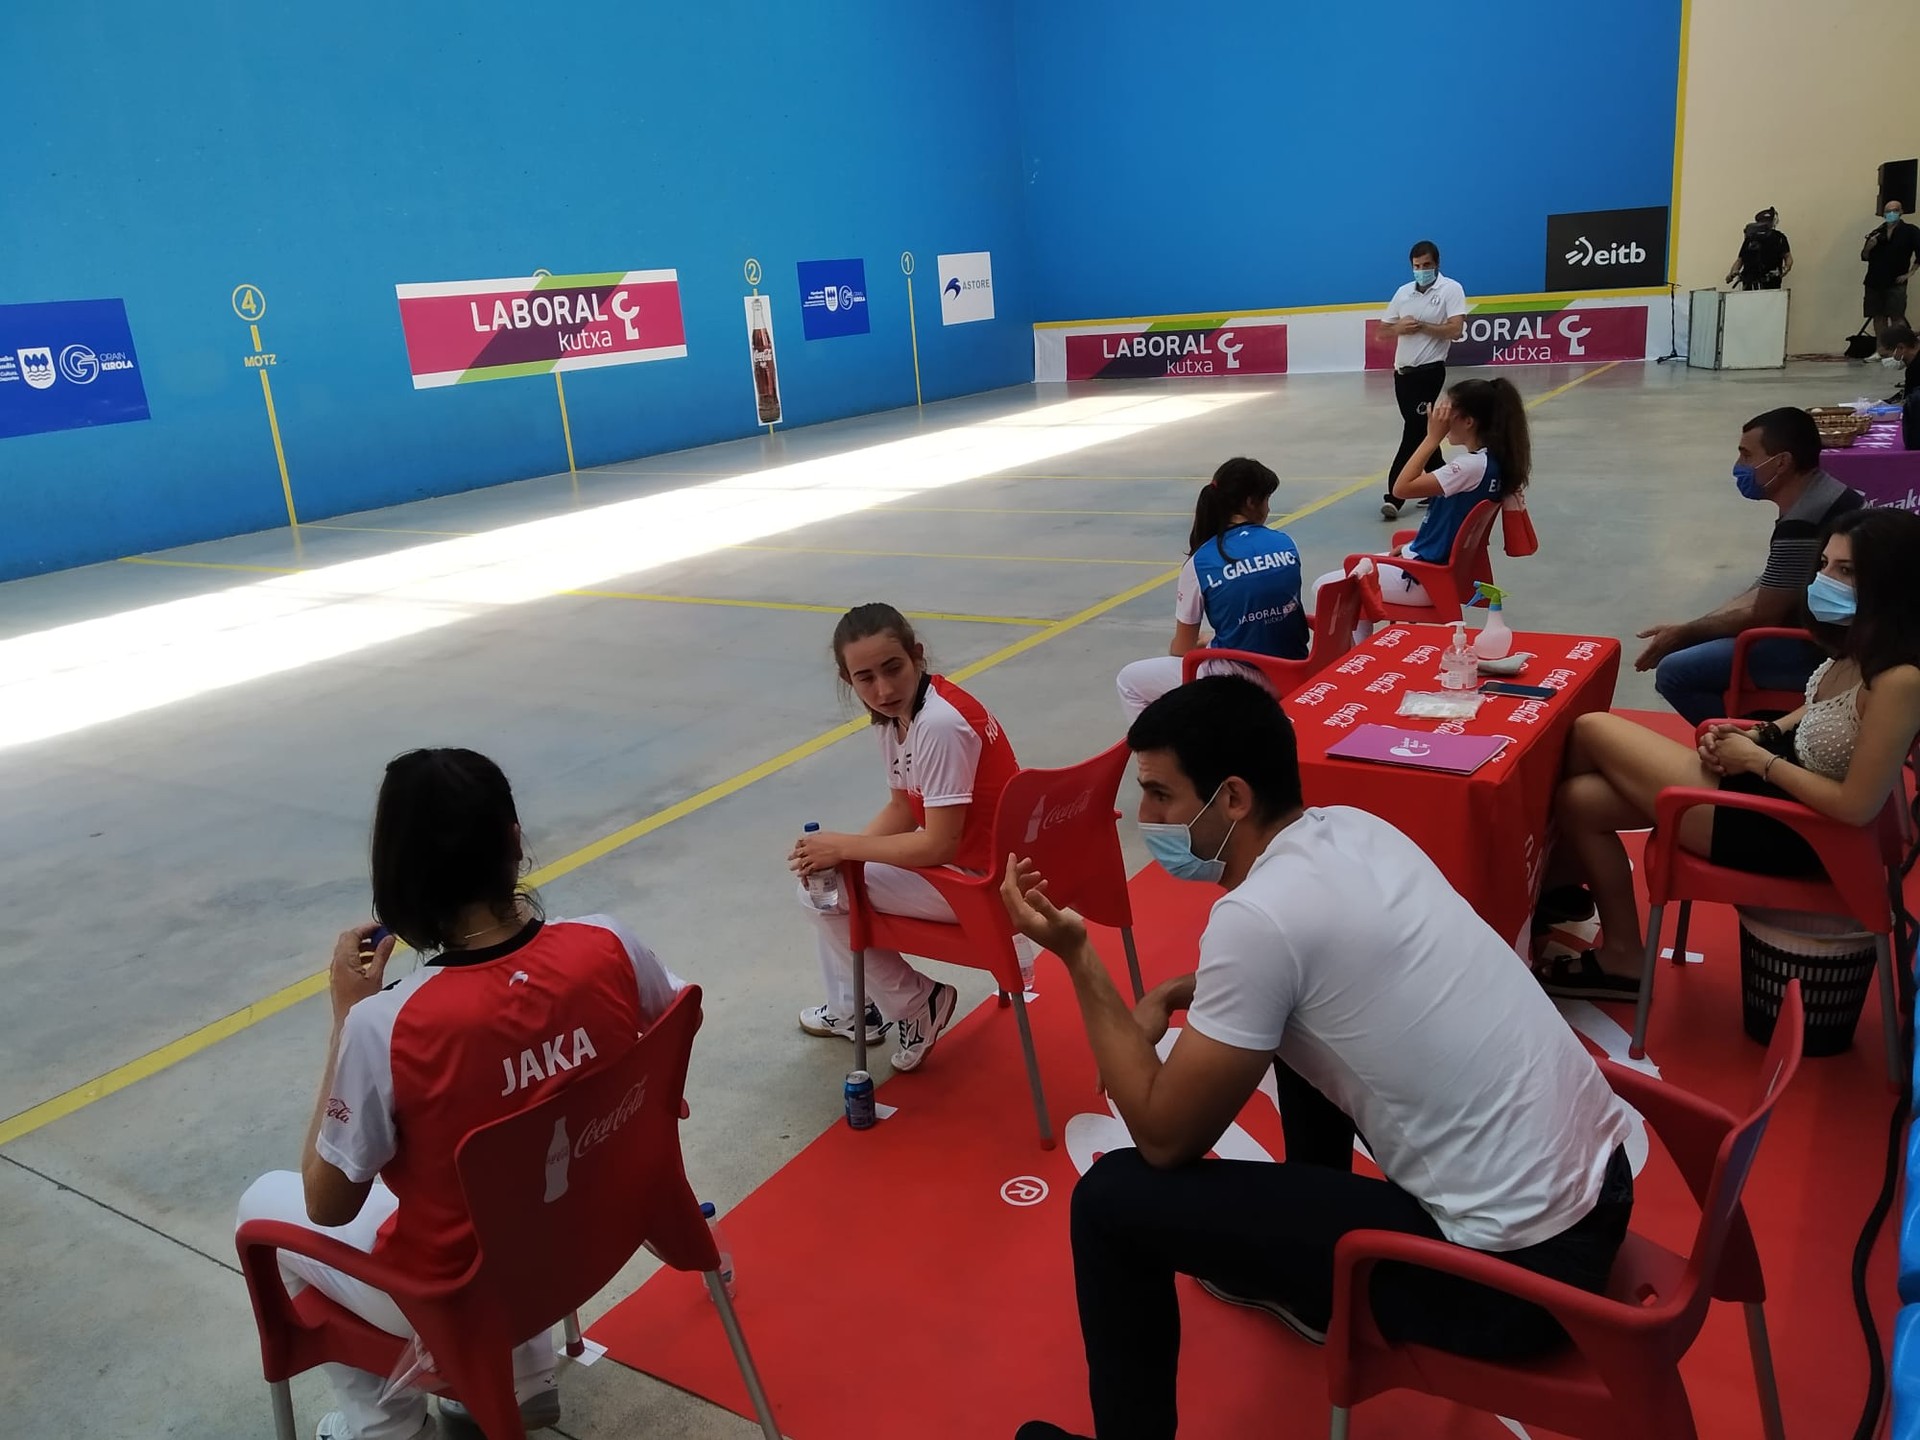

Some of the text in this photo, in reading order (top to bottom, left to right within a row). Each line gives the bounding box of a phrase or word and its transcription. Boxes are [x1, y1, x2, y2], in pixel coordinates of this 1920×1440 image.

[1594, 241, 1647, 267] eitb
[748, 261, 758, 282] 2
[962, 278, 990, 291] ASTORE
[241, 289, 257, 314] 4
[470, 293, 609, 333] LABORAL
[558, 329, 613, 352] kutxa
[1102, 333, 1213, 359] LABORAL
[99, 352, 127, 362] ORAIN
[244, 354, 277, 368] MOTZ
[1493, 344, 1552, 362] kutxa
[101, 360, 135, 371] KIROLA
[1166, 358, 1214, 375] kutxa
[1206, 573, 1223, 589] L.
[500, 1026, 598, 1097] JAKA
